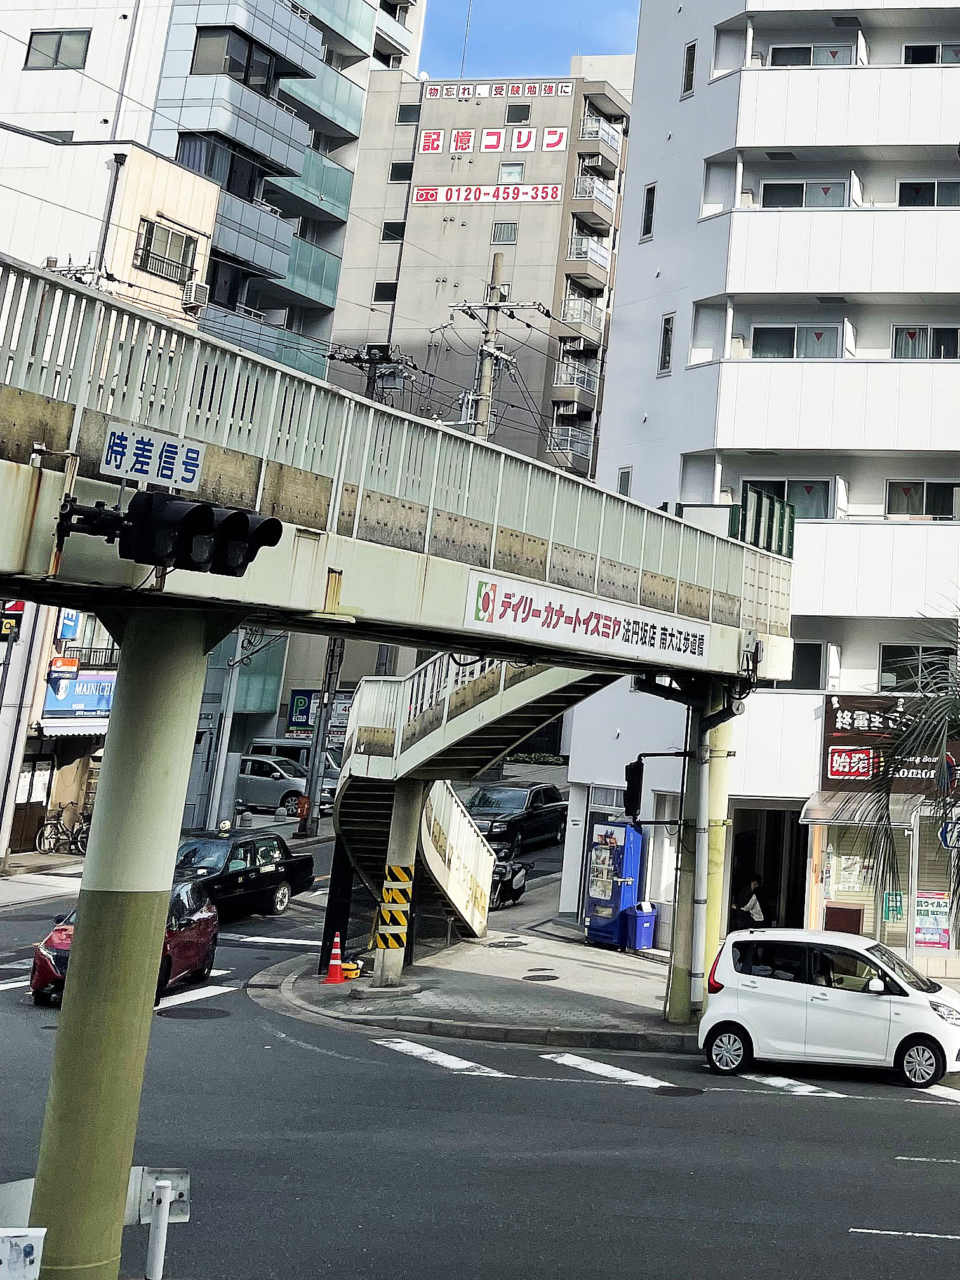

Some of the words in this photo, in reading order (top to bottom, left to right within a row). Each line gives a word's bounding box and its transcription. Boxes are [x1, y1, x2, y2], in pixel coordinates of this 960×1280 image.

[428, 83, 571, 98] 物忘れ、受験勉強に
[422, 130, 564, 151] 記憶コリン
[445, 185, 559, 202] 0120-459-358
[105, 431, 200, 484] 時差信号
